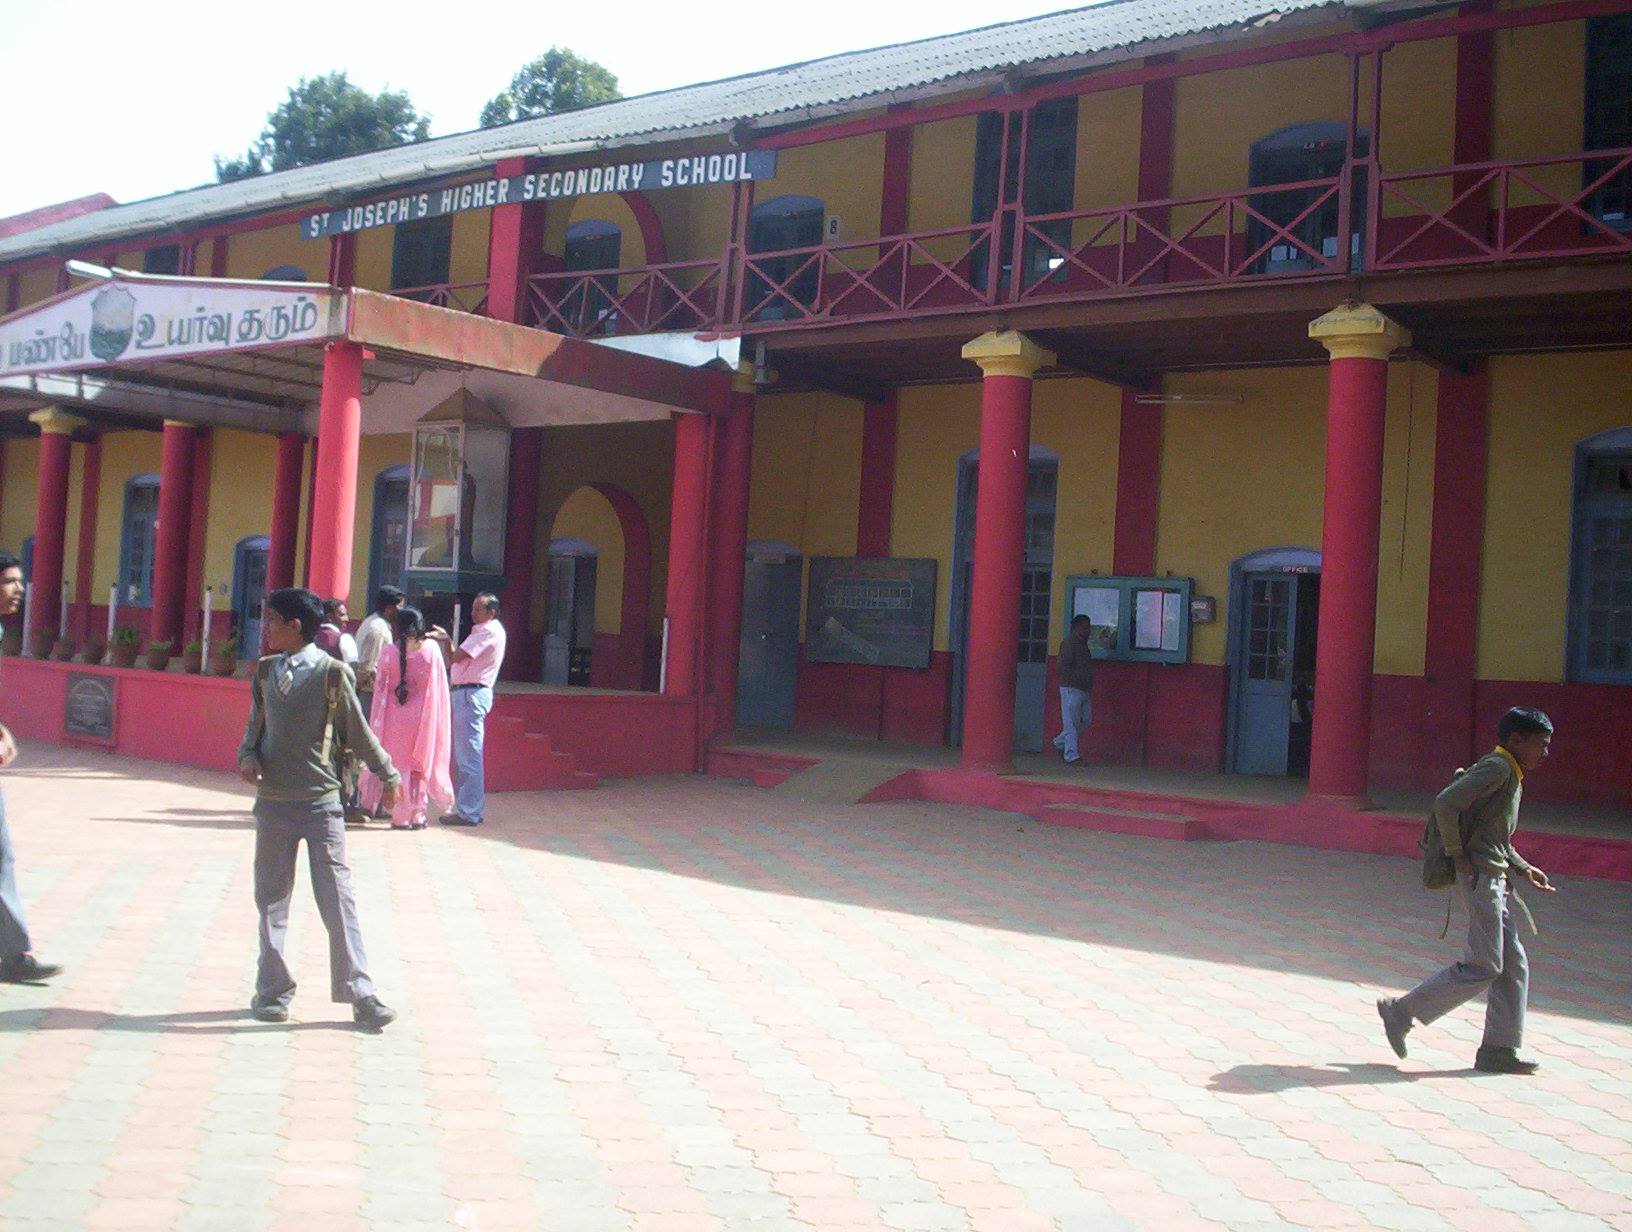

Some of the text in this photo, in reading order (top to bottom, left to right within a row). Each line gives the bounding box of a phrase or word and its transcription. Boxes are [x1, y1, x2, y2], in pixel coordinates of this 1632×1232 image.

[342, 193, 429, 232] JOSEPH'S
[441, 177, 510, 213] HIGHER
[523, 163, 645, 200] SECONDARY
[661, 152, 753, 188] SCHOOL
[135, 306, 232, 349] உயர்வு
[235, 296, 318, 343] தரும்
